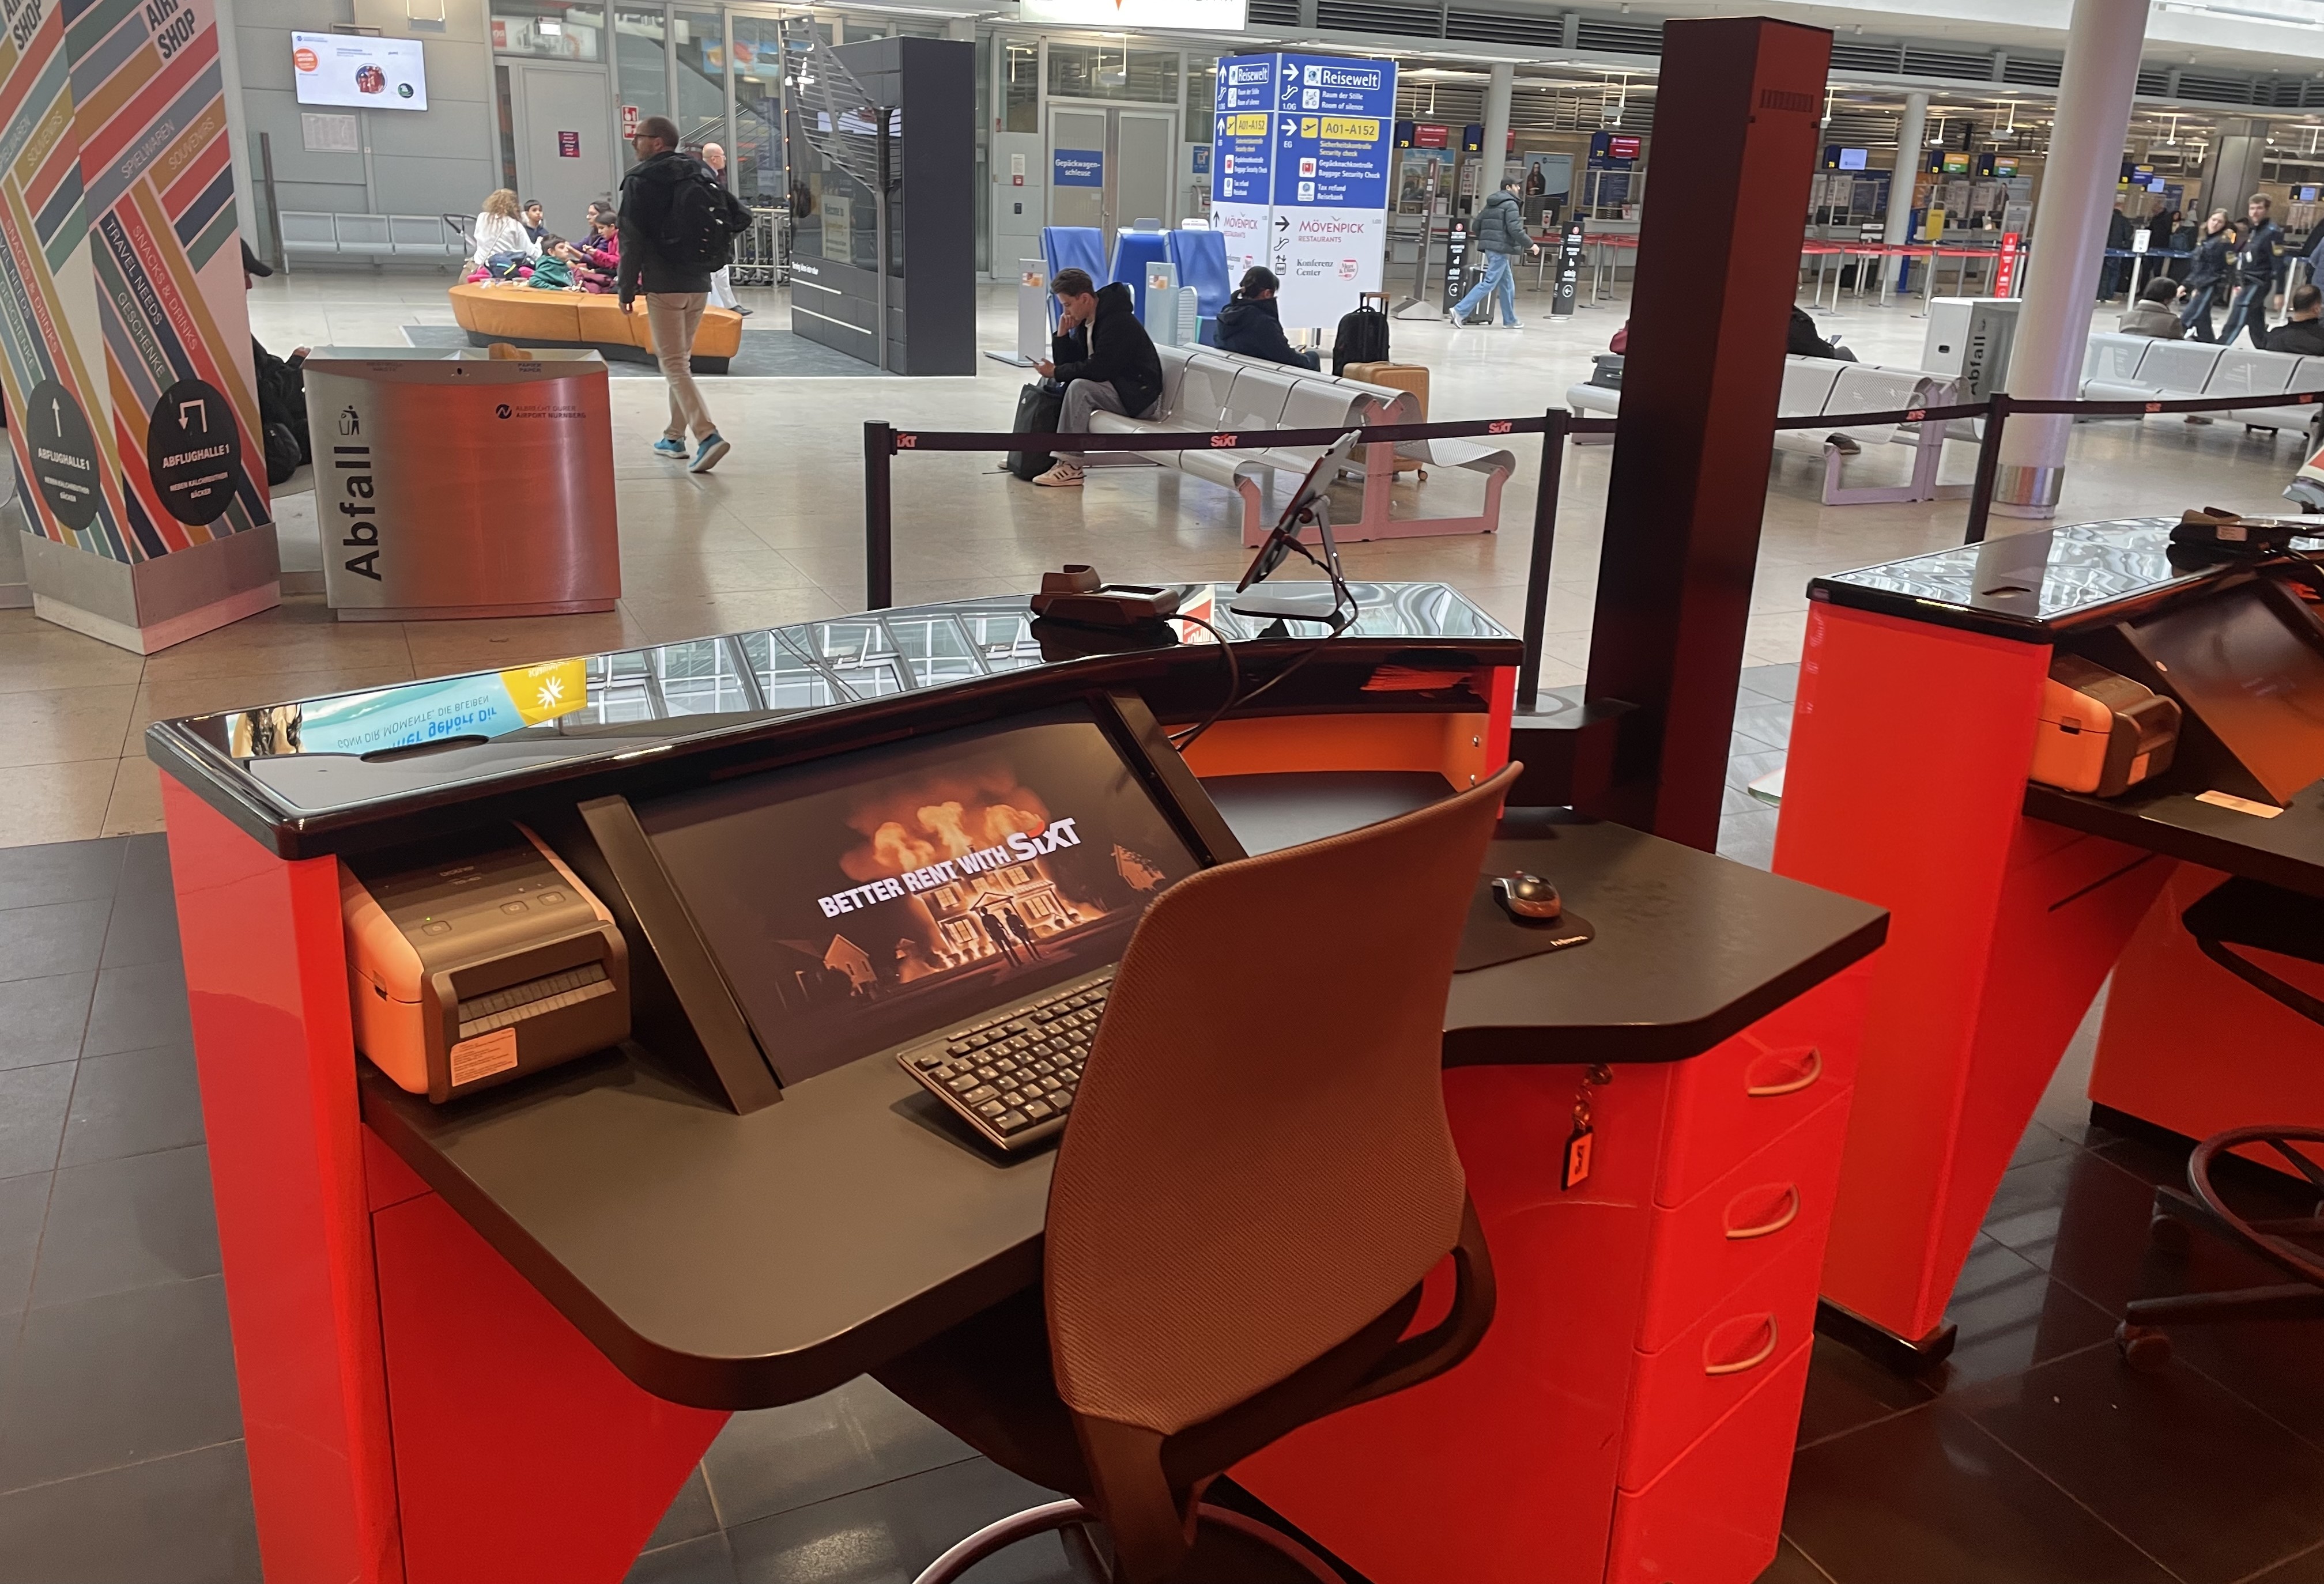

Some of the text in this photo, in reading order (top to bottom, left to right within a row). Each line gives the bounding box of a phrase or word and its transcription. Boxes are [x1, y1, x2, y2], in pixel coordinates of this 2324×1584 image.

[13, 0, 42, 50] SHOP
[158, 8, 195, 59] SHOP
[1239, 67, 1267, 81] Reisewelt
[1323, 70, 1378, 87] Reisewelt
[122, 119, 176, 179] SPIELWAREN
[169, 117, 214, 170] SOUVENIRS
[1326, 123, 1375, 135] A01-A152
[1299, 220, 1364, 233] MÖVENPICK
[107, 218, 163, 326] TRAVEL NEEDS
[133, 225, 165, 285] SNACKS
[169, 298, 198, 351] DRINKS
[1297, 259, 1334, 267] Konferenz
[1297, 268, 1321, 276] Center
[118, 292, 165, 379] GESCHENKE
[163, 444, 230, 468] ABFLUGHALLE 1
[1211, 433, 1238, 447] SIXT
[334, 447, 382, 582] Abfall
[817, 877, 905, 918] BETTER
[901, 860, 957, 892] RENT
[956, 845, 1012, 875] WITH
